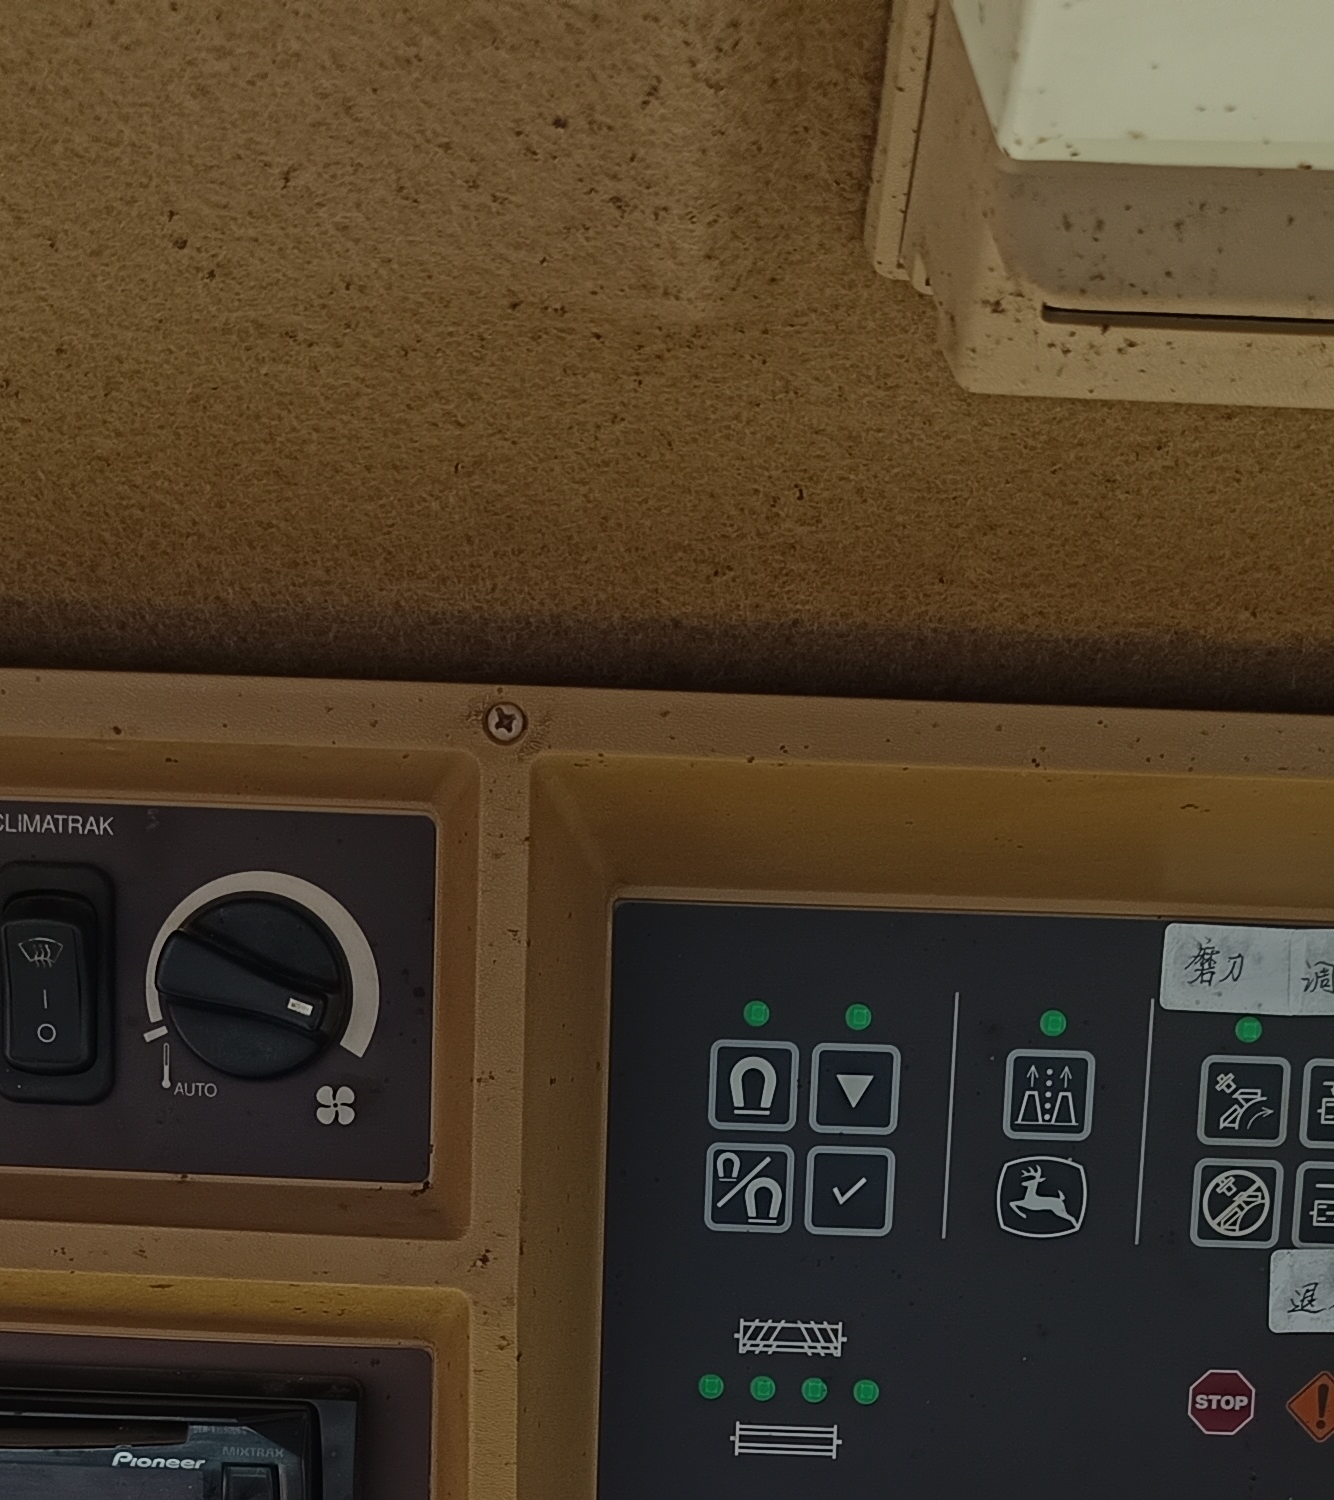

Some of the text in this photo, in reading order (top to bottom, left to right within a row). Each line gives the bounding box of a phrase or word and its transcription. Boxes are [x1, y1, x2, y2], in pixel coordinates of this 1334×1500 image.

[173, 1082, 218, 1098] AUTO
[1195, 1394, 1249, 1411] STOP
[222, 1446, 285, 1458] MIXTRAX
[111, 1451, 206, 1470] Pioneer
